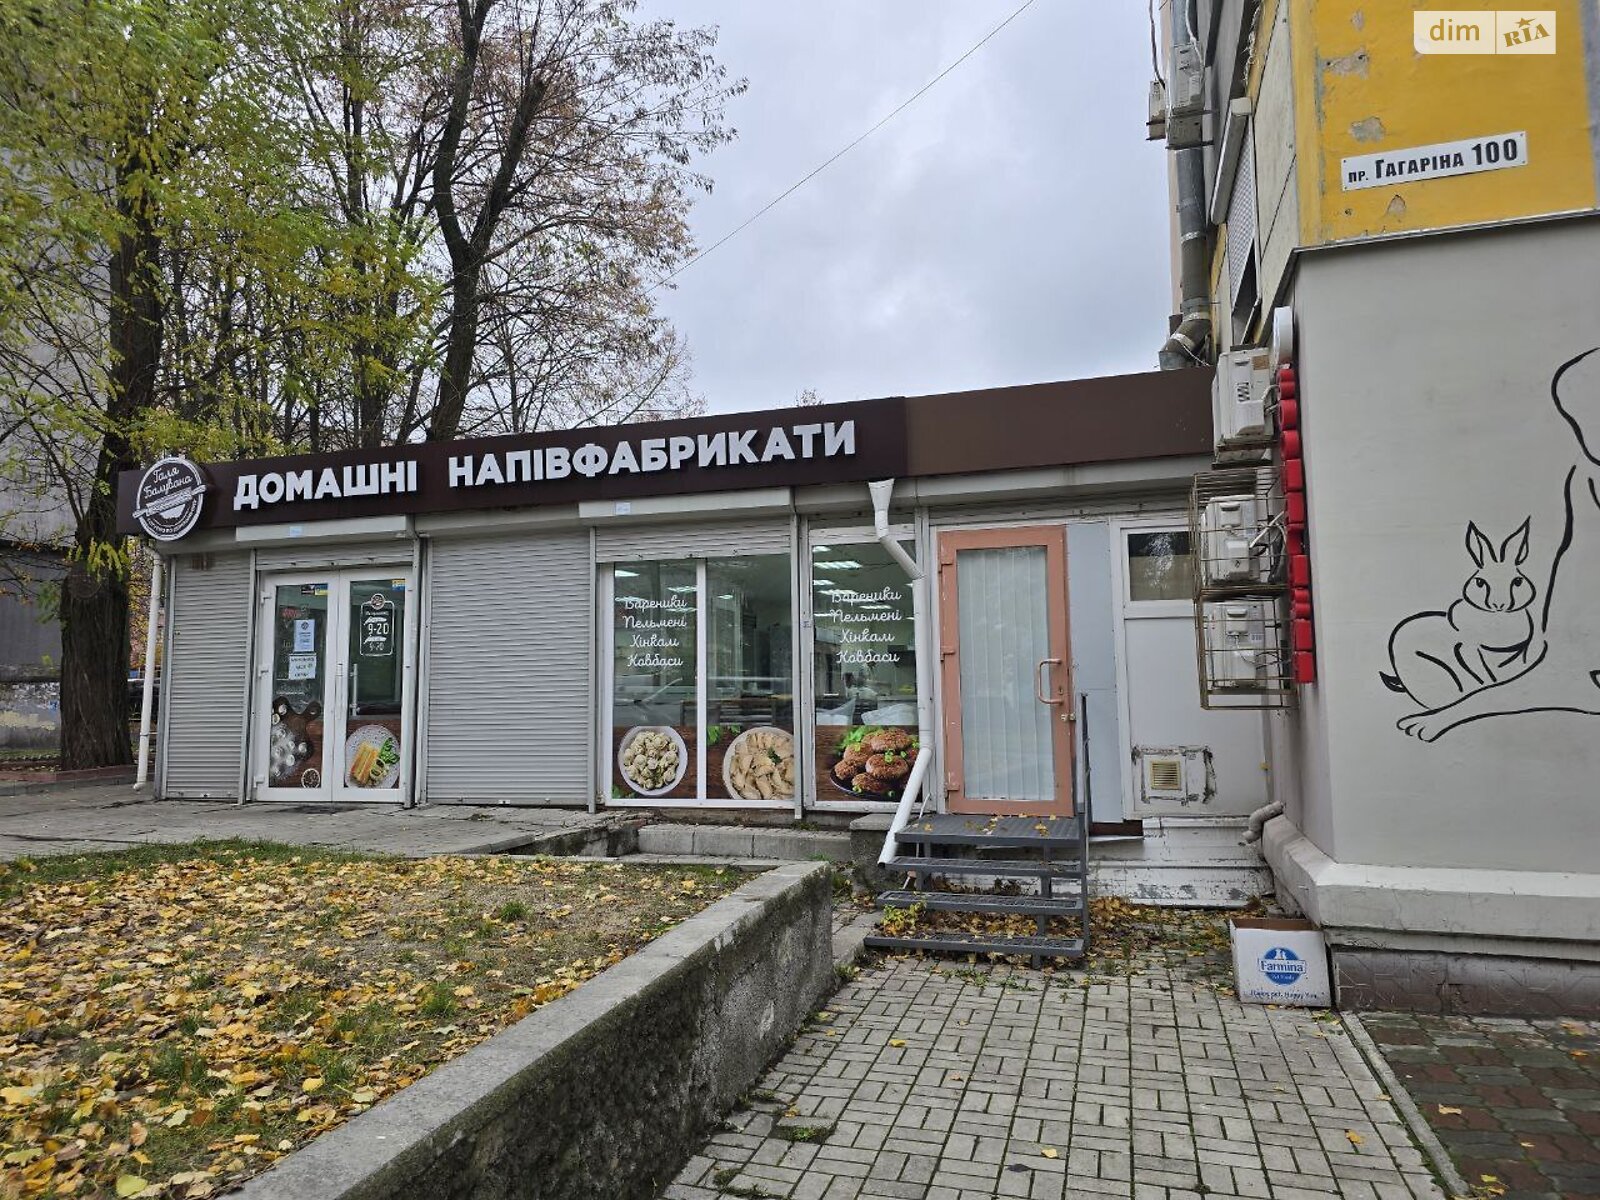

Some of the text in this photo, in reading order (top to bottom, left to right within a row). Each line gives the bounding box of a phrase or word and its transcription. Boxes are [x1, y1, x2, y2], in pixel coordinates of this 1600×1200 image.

[1472, 138, 1517, 165] 100
[233, 420, 856, 511] ДОМАШНІ НАПІВФАБРИКАТИ
[153, 467, 180, 484] Галя
[143, 475, 193, 499] Балувана
[624, 594, 688, 613] Вареники
[831, 586, 903, 607] Вареники
[622, 614, 688, 629] Пельмені
[829, 608, 903, 623] Пельмені
[368, 623, 390, 635] 9-20
[627, 653, 684, 667] Ковбаси
[835, 649, 901, 664] Ковбаси
[1260, 960, 1304, 973] Farmina
